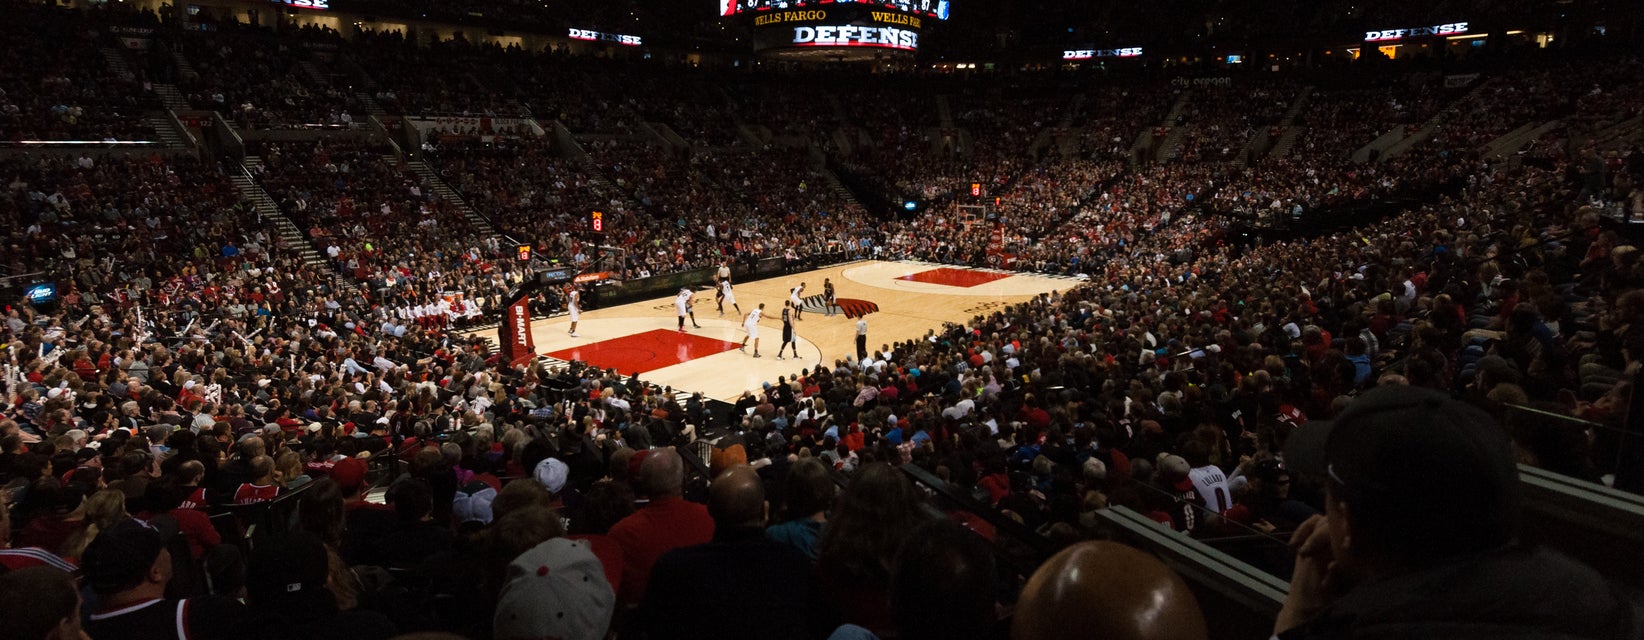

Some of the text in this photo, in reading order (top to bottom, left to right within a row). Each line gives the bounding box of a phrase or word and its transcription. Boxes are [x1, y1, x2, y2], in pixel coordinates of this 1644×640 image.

[755, 10, 826, 26] WELLS FARGO
[871, 12, 909, 25] WELLS
[569, 28, 642, 45] DEFENSE
[793, 24, 918, 48] DEFENSE
[1364, 22, 1468, 41] DEFENSE
[1063, 47, 1142, 59] DEFENSE
